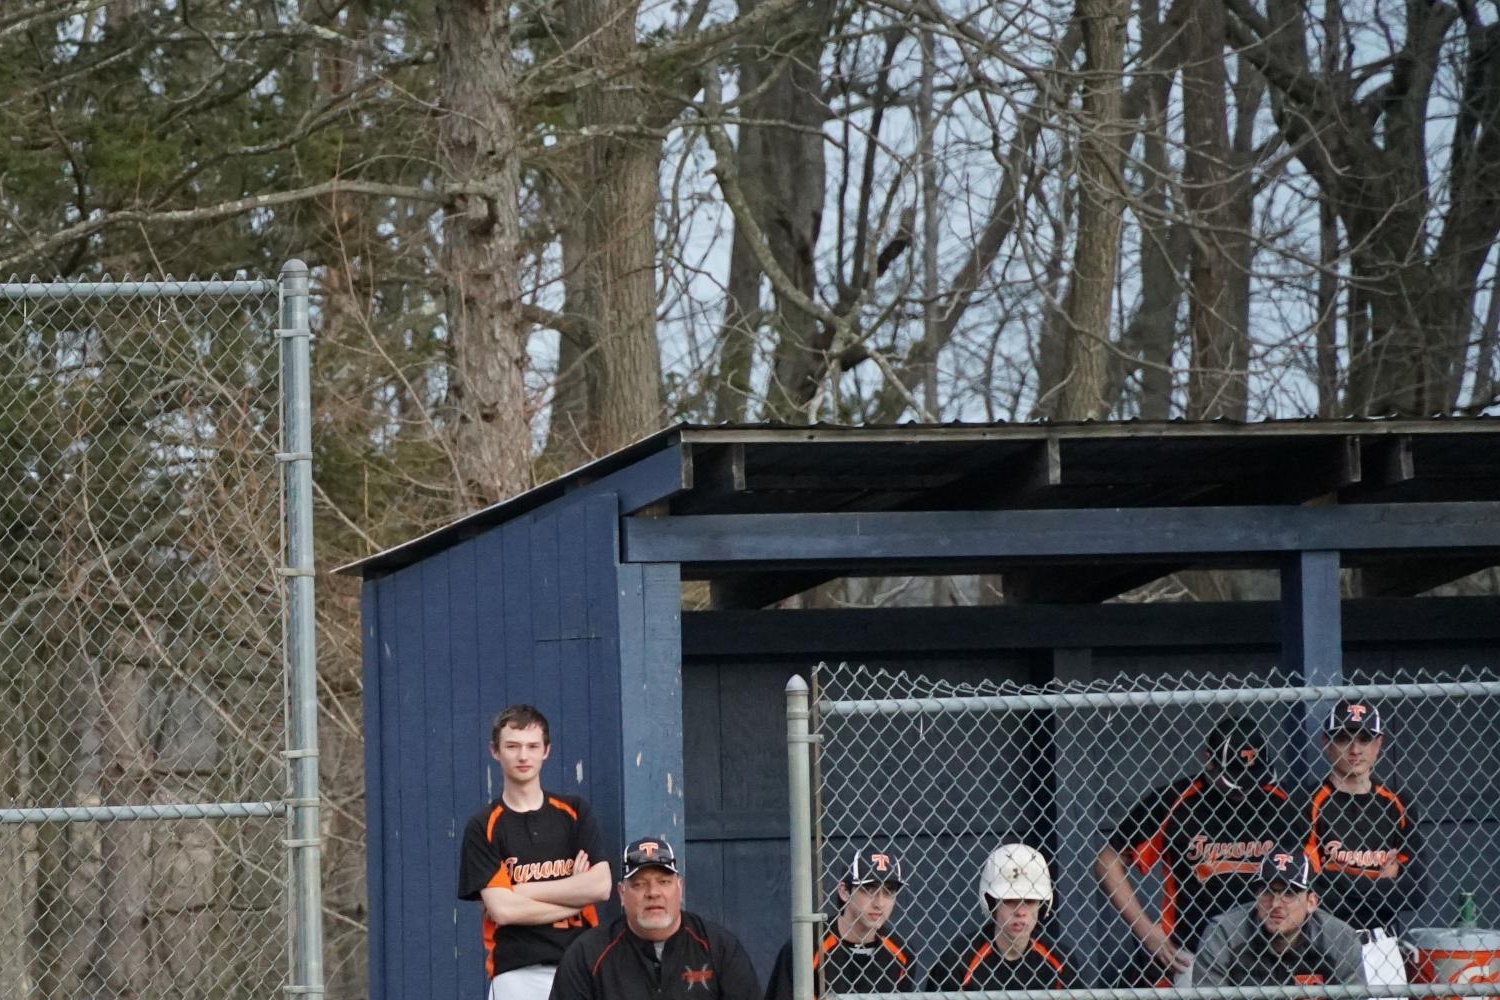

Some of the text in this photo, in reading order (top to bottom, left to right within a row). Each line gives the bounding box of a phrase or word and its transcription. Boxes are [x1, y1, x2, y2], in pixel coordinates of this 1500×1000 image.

[638, 842, 659, 858] T
[1186, 834, 1275, 864] Tyrone
[871, 854, 890, 872] T
[1273, 853, 1294, 872] T
